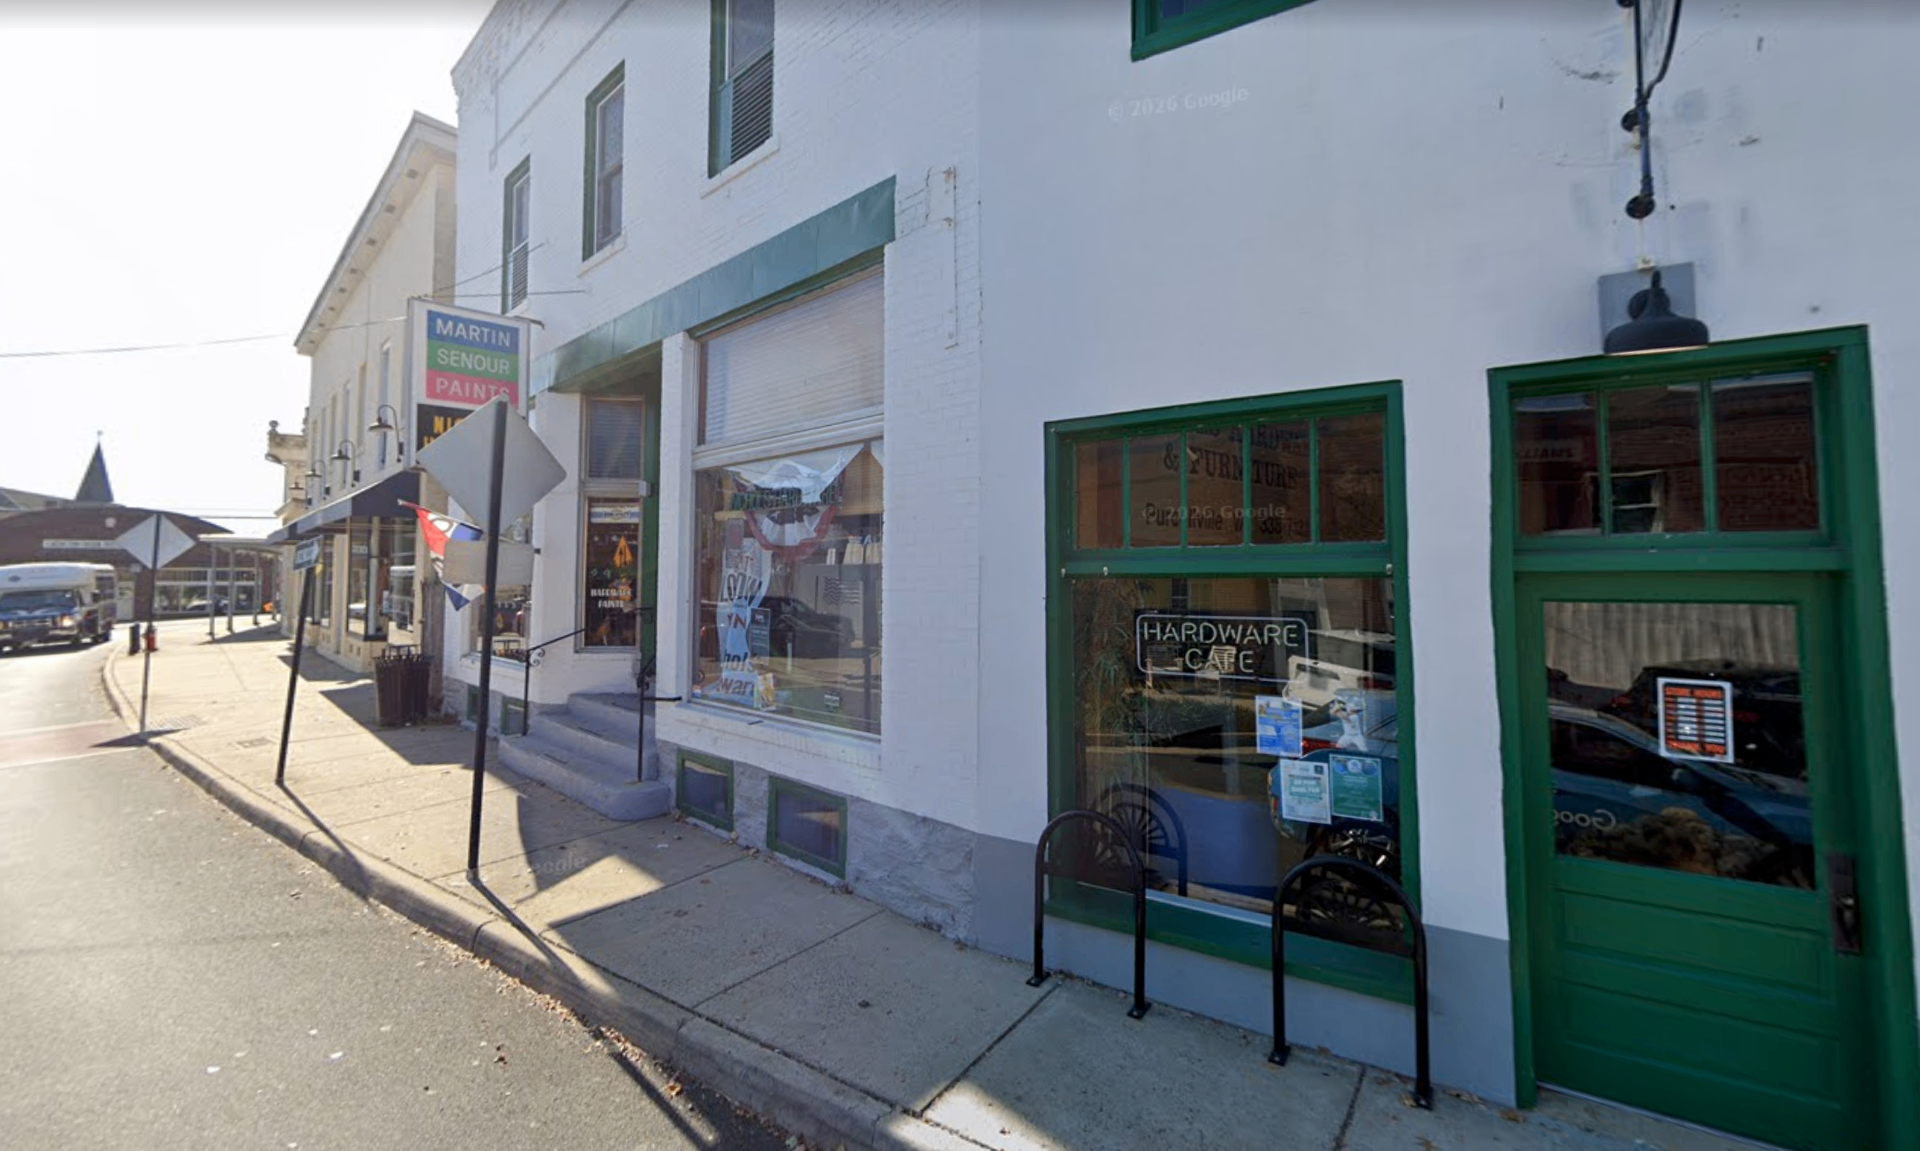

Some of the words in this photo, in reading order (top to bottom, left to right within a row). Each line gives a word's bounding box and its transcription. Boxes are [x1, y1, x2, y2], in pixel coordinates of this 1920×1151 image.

[435, 317, 511, 347] MARTIN
[437, 348, 510, 375] SENOUR
[1163, 443, 1180, 472] &
[1187, 446, 1299, 490] FURNTURE
[1143, 621, 1299, 647] HARDWARE
[1184, 648, 1255, 673] CAFE
